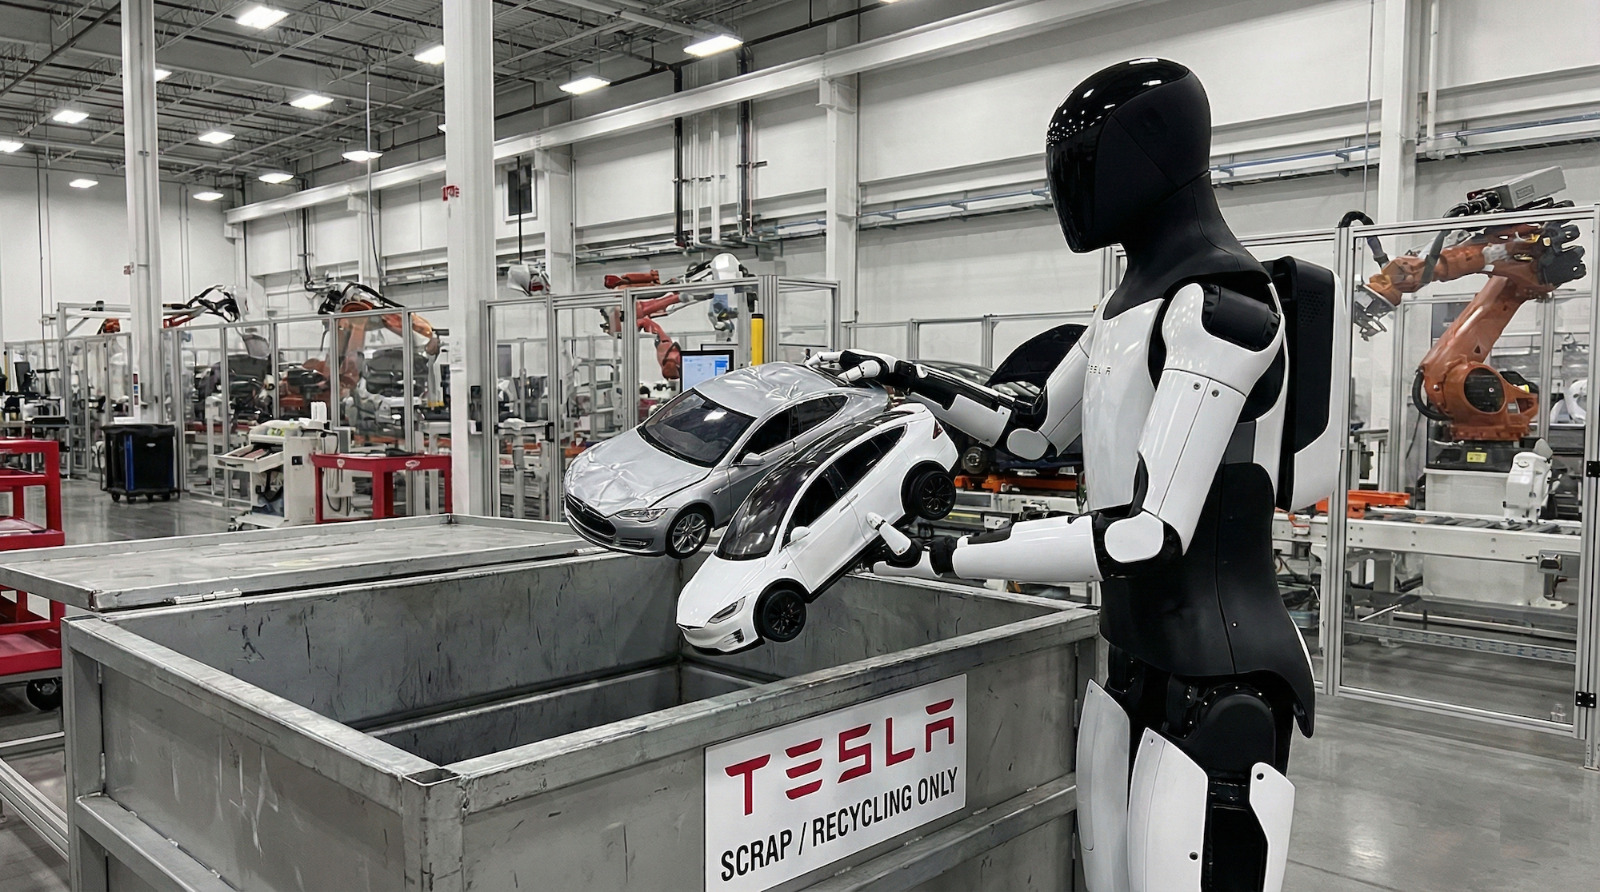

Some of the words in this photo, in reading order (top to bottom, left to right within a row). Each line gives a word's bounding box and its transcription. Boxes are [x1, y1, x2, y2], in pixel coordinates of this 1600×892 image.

[725, 698, 955, 816] TESLA
[721, 829, 793, 882] SCRAP
[798, 821, 807, 856] /
[812, 784, 912, 847] RECYCLING
[917, 766, 958, 805] ONLY
